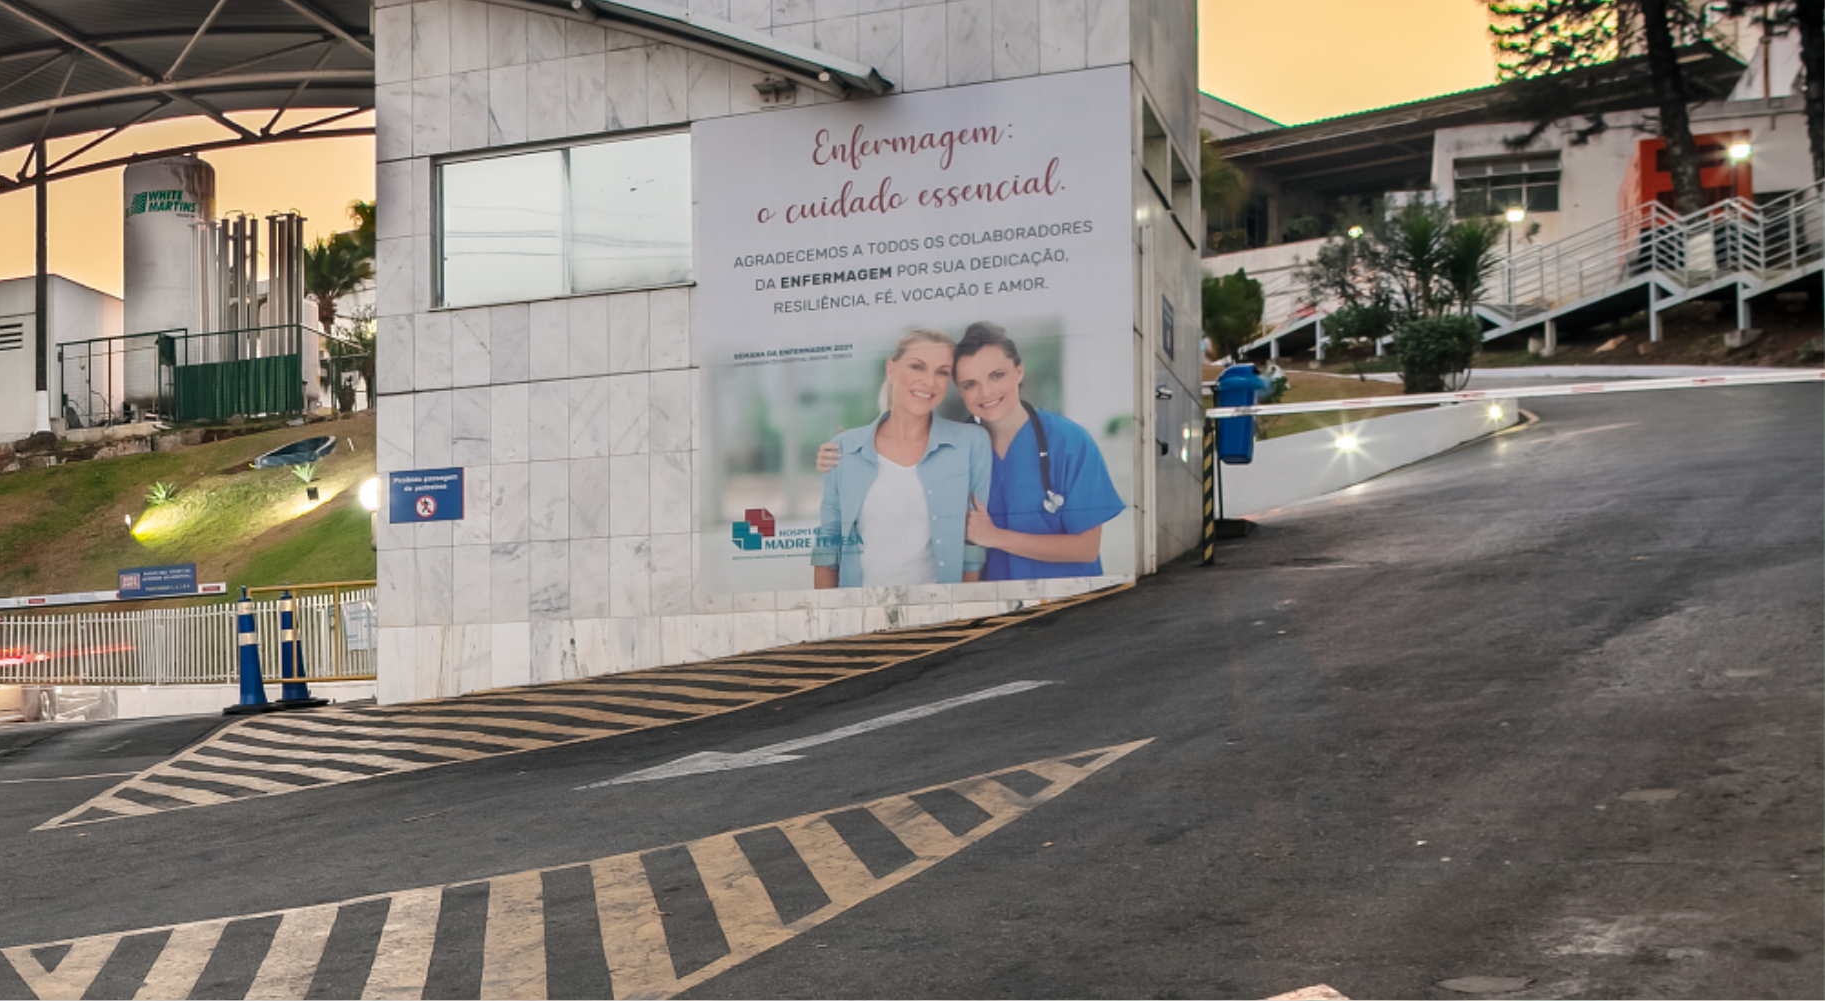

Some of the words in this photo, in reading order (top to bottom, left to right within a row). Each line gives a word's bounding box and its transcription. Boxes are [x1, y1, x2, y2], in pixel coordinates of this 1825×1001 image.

[812, 123, 1014, 171] Enfermagem:
[148, 189, 183, 201] WHITE
[757, 206, 777, 224] o
[785, 176, 910, 224] cuidado
[917, 157, 1066, 208] essencial.
[148, 201, 196, 213] MARTINS
[733, 246, 849, 269] AGRADECEMOS
[852, 243, 864, 256] A
[867, 238, 920, 256] TODOS
[923, 236, 945, 250] OS
[948, 220, 1094, 248] COLABORADORES
[755, 278, 777, 292] DA
[780, 266, 892, 290] ENFERMAGEM
[896, 263, 929, 278] POR
[932, 259, 966, 275] SUA
[970, 248, 1070, 272] DEDICAÇÃO,
[773, 291, 870, 315] RESILIÊNCIA,
[875, 288, 897, 306] FÉ,
[901, 282, 979, 304] VOCAÇÃO
[984, 281, 994, 296] E
[997, 277, 1050, 294] AMOR.
[779, 345, 832, 356] ENFERMAGEM
[765, 537, 812, 550] MADRE
[815, 534, 865, 548] TERESA
[779, 527, 822, 537] HOSPITAL
